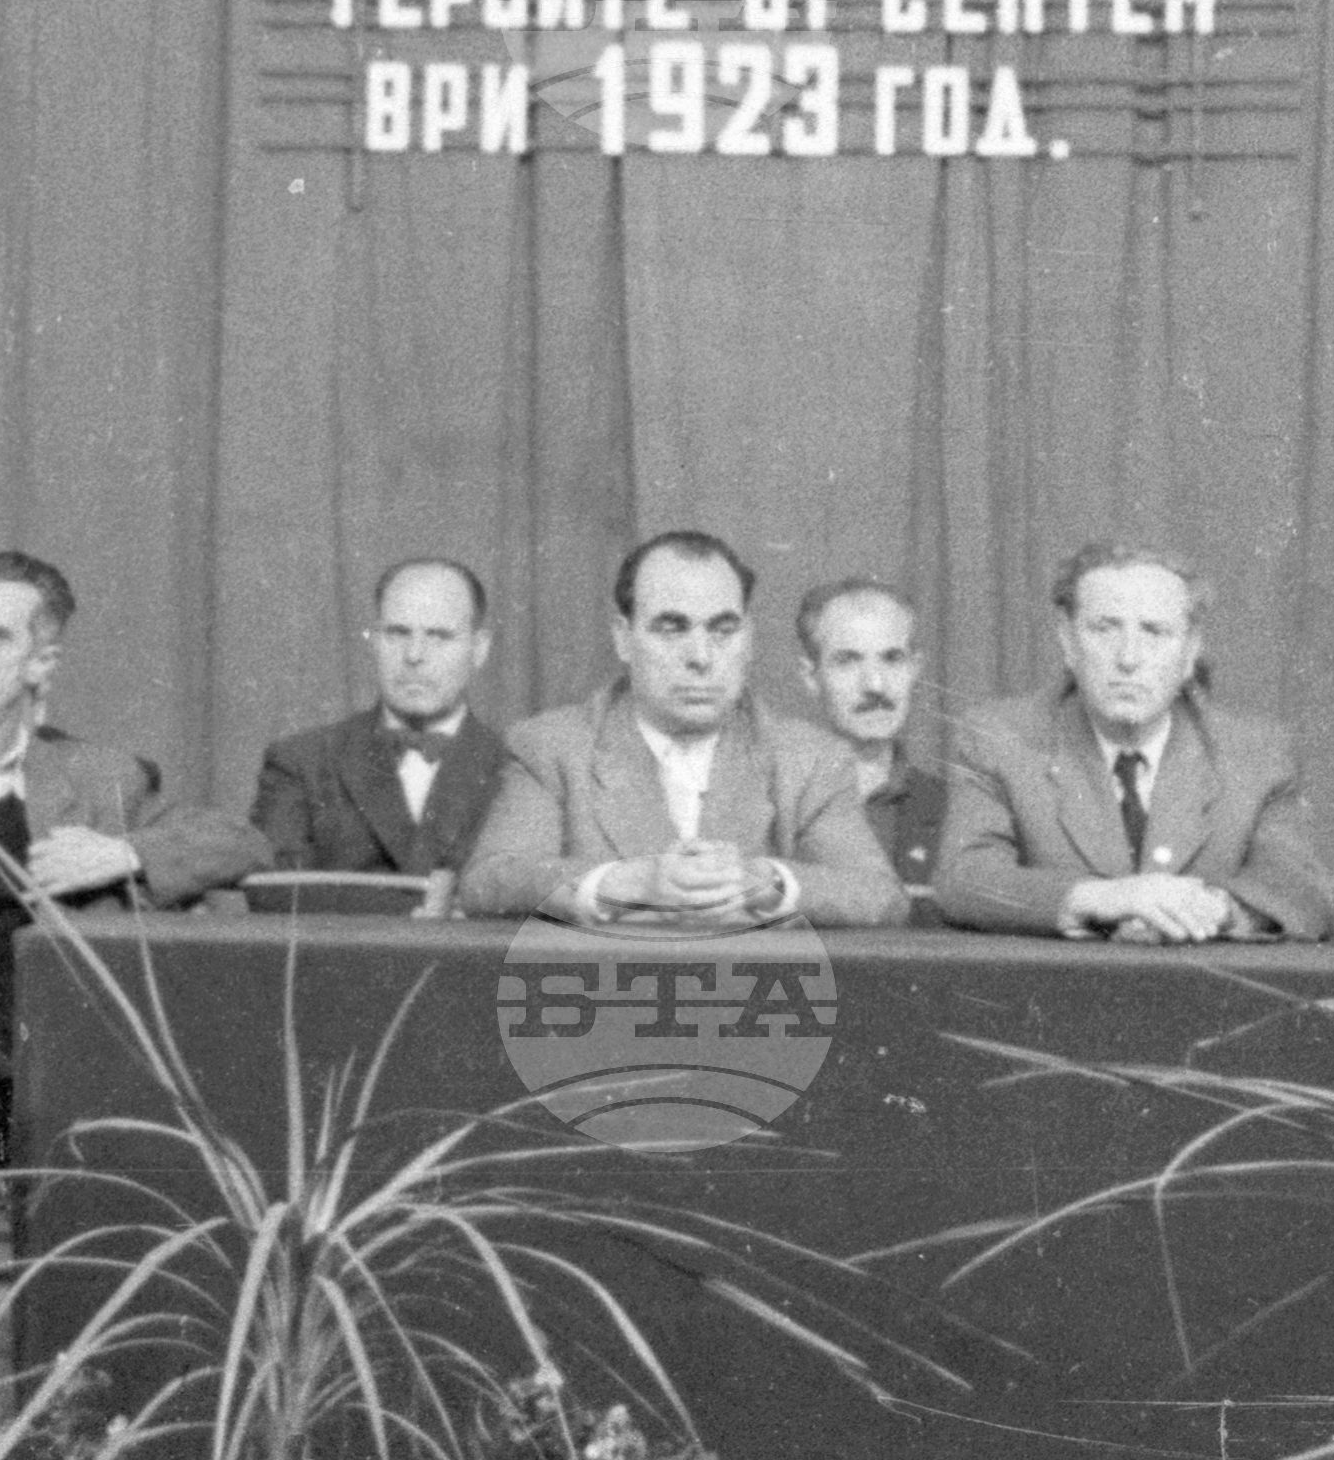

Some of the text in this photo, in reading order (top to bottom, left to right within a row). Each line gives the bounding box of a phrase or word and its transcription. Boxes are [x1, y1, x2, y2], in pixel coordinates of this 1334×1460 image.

[365, 38, 1071, 160] ВРИ 1923 ГОД.
